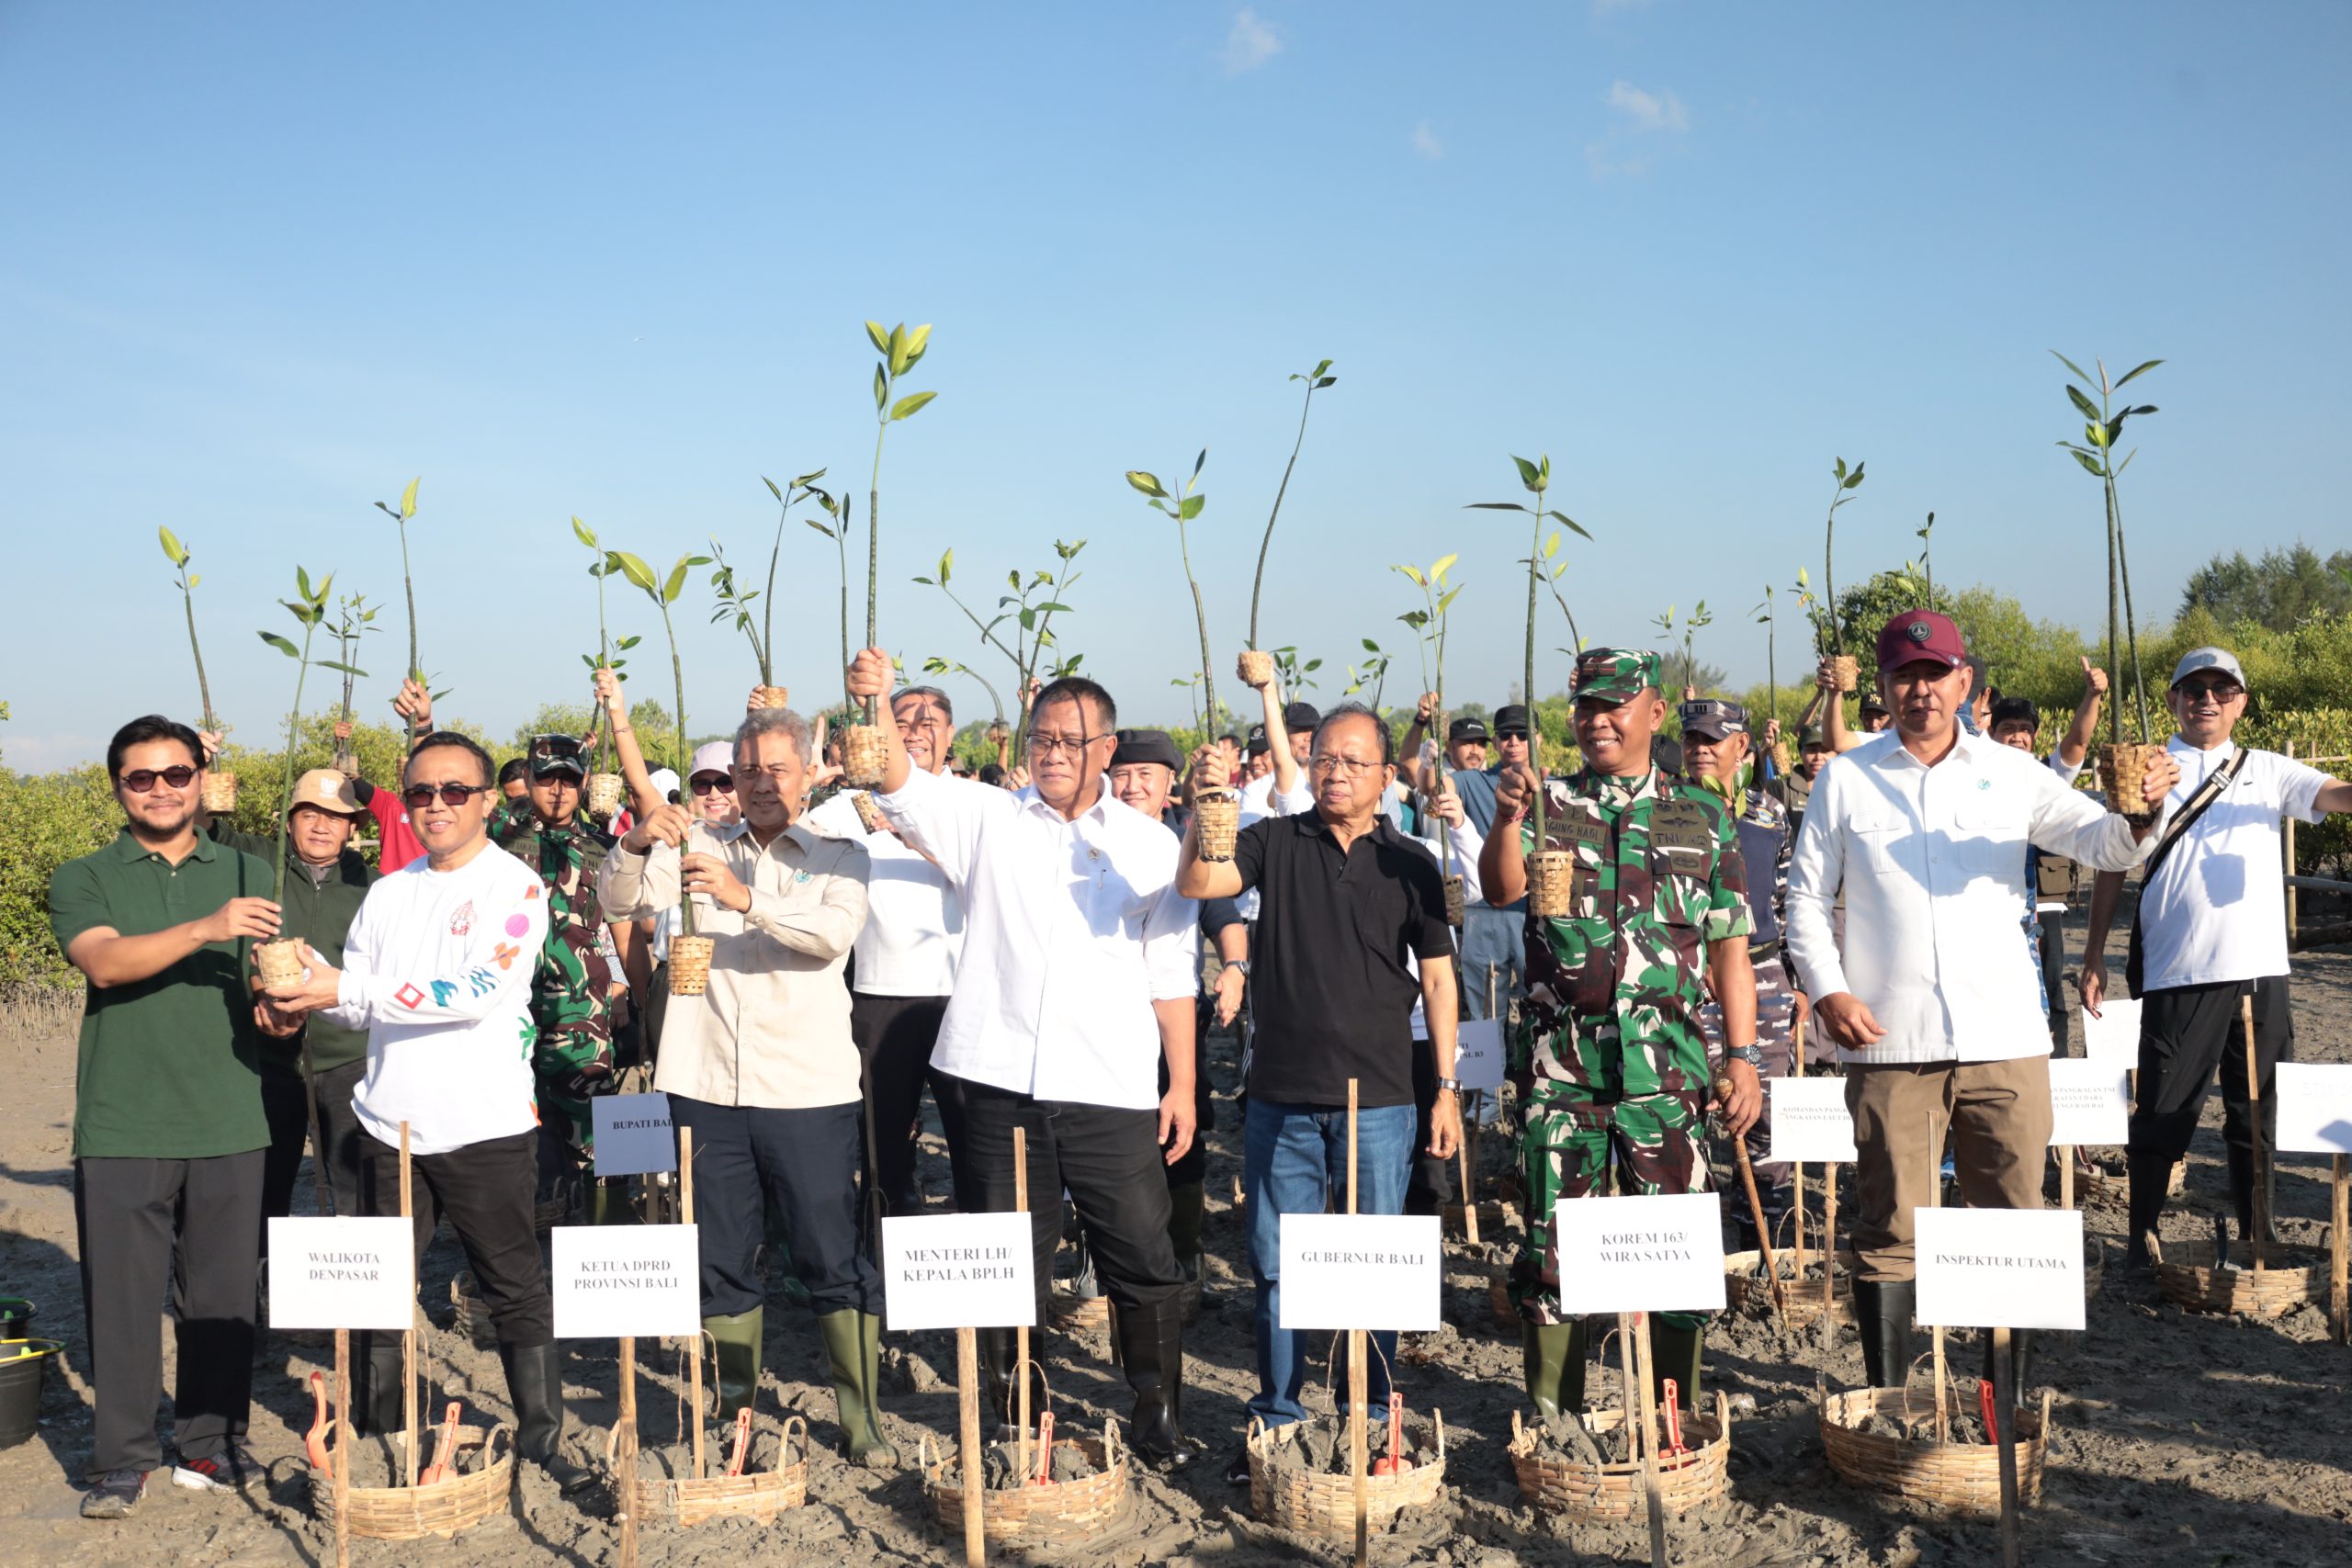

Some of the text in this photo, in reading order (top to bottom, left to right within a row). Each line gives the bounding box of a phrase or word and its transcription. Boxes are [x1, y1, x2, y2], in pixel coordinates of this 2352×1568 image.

[1654, 831, 1680, 844] TNI
[613, 1120, 650, 1130] BUPATI
[1601, 1231, 1689, 1246] KOREM 163/
[308, 1252, 380, 1264] WALIKOTA
[904, 1247, 1012, 1262] MENTERI LH/
[1301, 1251, 1424, 1266] GUBERNUR BALI
[1600, 1249, 1690, 1263] WIRA SATYA
[581, 1259, 672, 1272] KETUA DPRD
[1936, 1254, 2066, 1269] INSPEKTUR UTAMA
[309, 1269, 379, 1280] DENPASAR
[903, 1267, 1014, 1282] KEPALA BPLH
[574, 1277, 678, 1290] PROVINSI BALI
